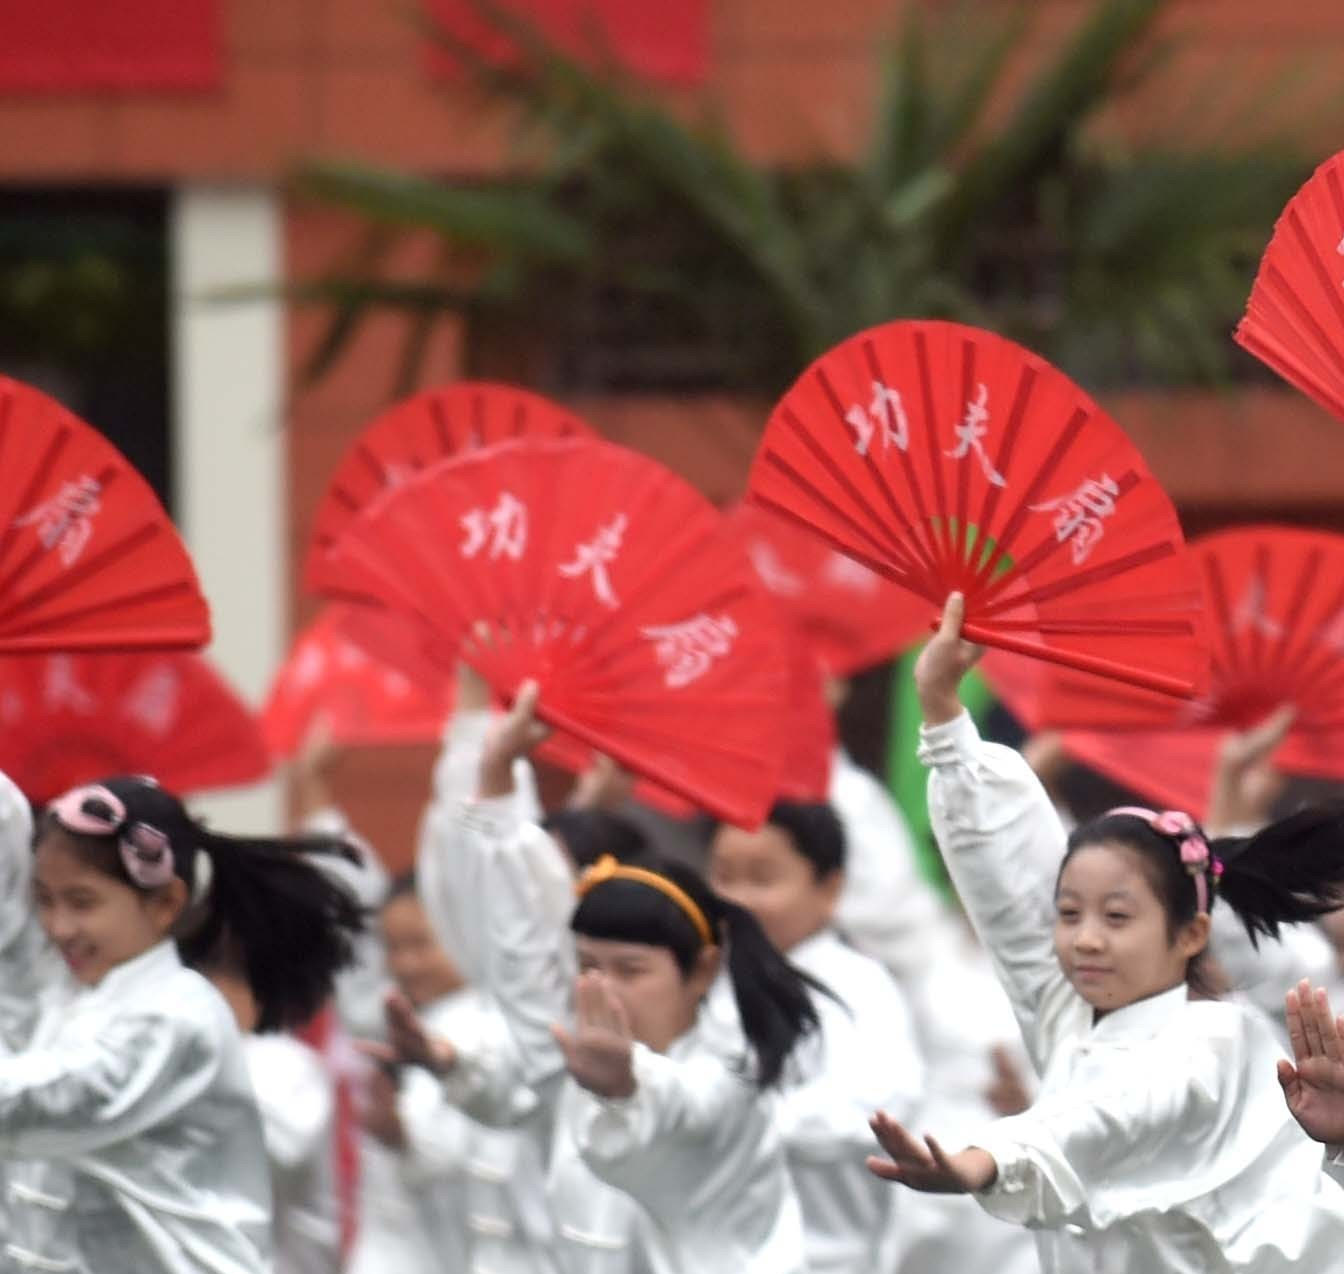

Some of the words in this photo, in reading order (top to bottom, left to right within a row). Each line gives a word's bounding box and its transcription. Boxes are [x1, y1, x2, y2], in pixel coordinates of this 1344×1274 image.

[846, 381, 1120, 566] 功夫扇
[458, 491, 740, 689] 功夫扇
